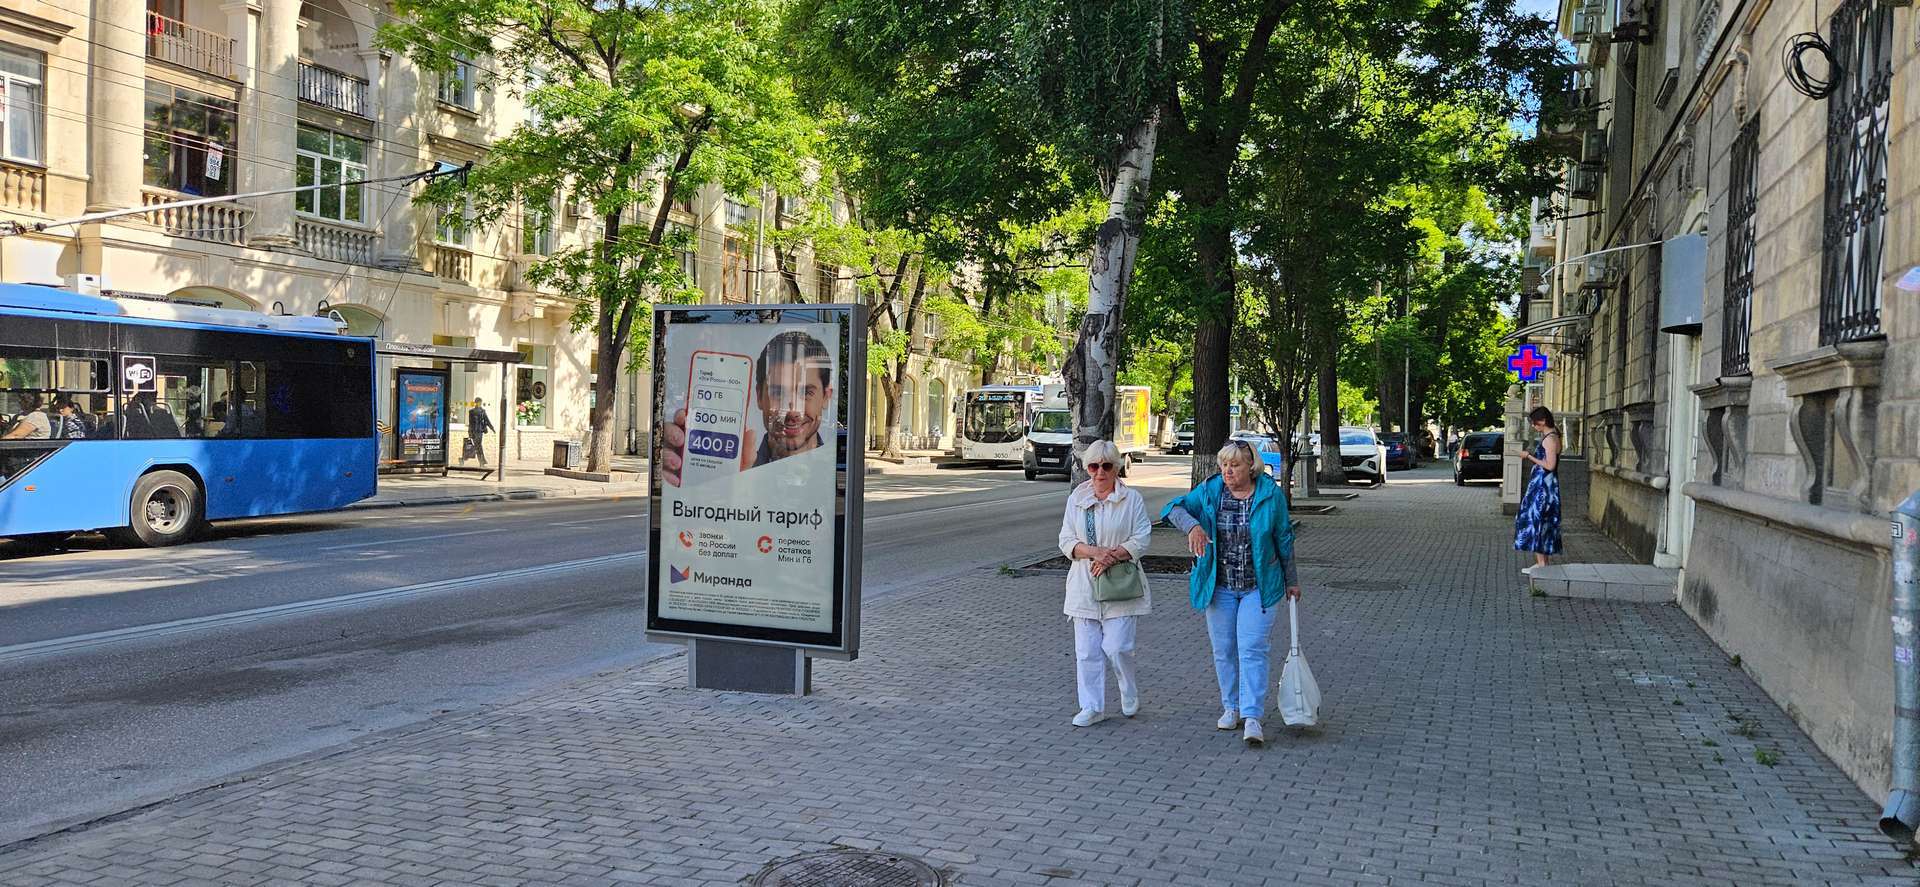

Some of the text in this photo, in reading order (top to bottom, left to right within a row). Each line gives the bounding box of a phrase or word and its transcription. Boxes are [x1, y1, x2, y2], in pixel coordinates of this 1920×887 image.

[697, 389, 724, 401] 50 ГБ
[694, 412, 737, 424] 500 МИН
[692, 436, 723, 452] 400
[672, 500, 823, 530] Выгодный тариф
[699, 532, 724, 540] звонки
[709, 541, 736, 550] России
[778, 538, 810, 547] перенос
[713, 550, 738, 559] доплат
[778, 547, 812, 555] остатков
[778, 554, 794, 562] Мин
[693, 571, 752, 587] Миранда
